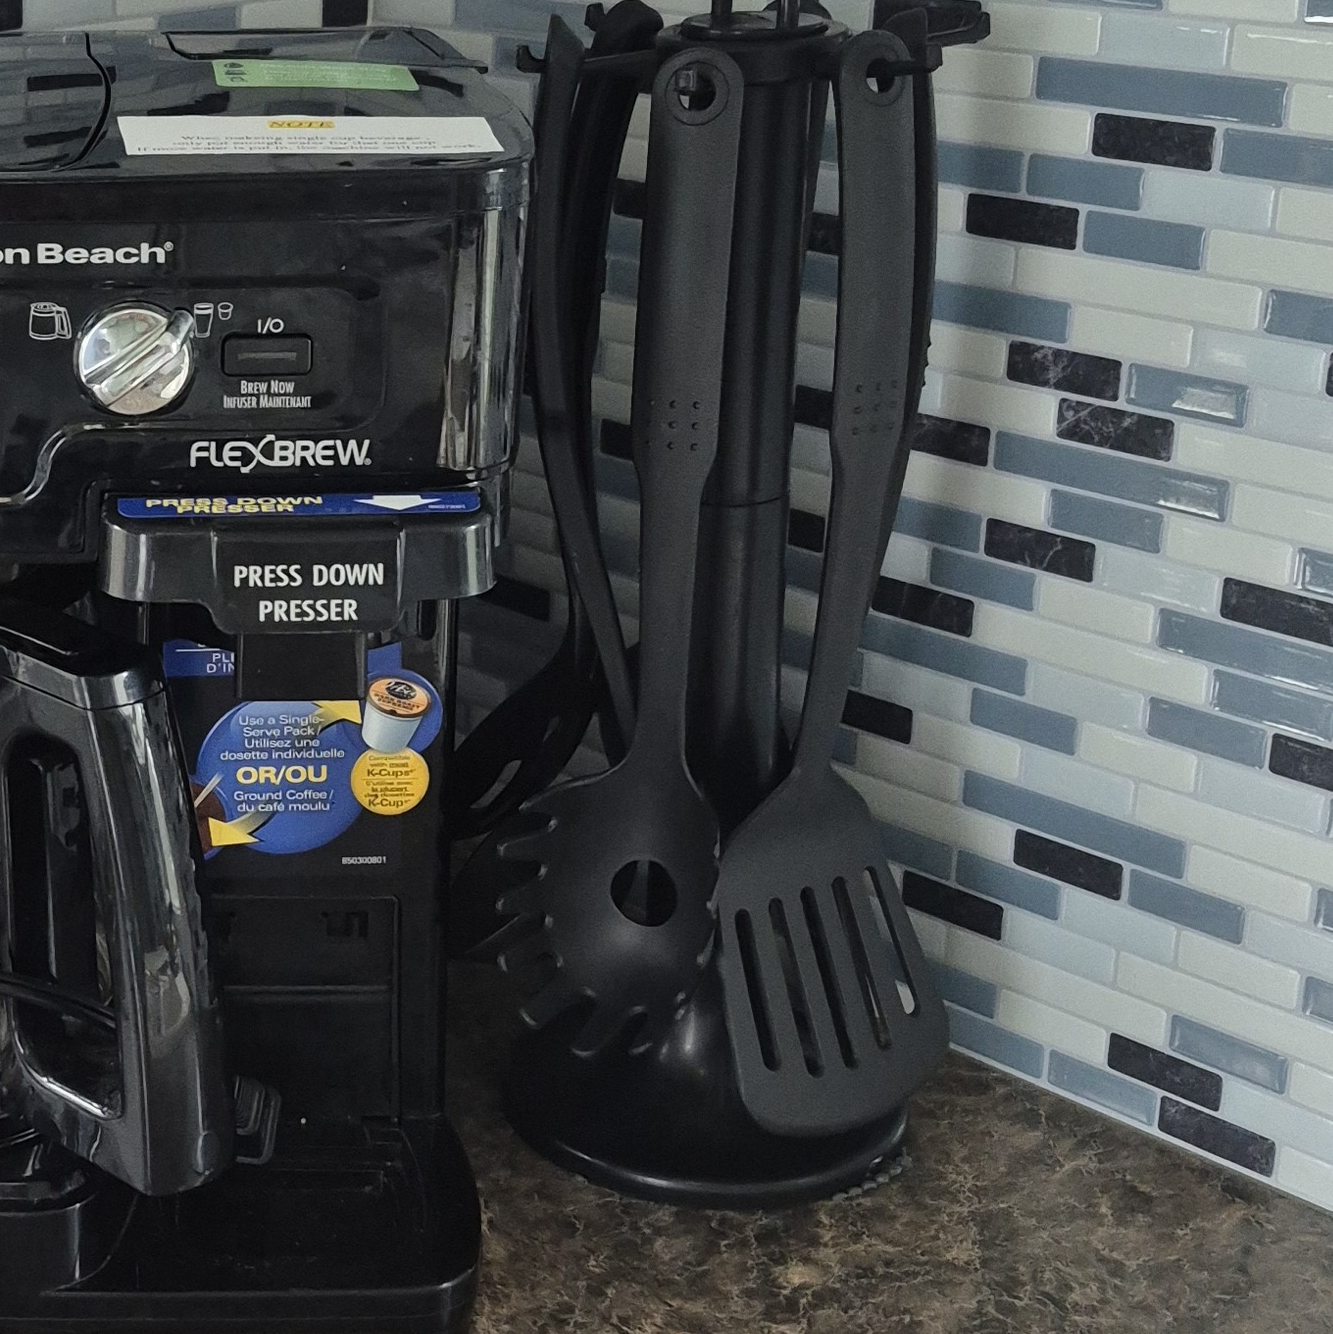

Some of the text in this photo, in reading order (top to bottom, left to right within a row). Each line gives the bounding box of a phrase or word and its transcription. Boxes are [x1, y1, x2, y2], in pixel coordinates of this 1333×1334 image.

[190, 434, 372, 473] FLEXBREW
[145, 495, 323, 509] PRESS DOWN
[176, 503, 295, 514] PRESSER
[233, 562, 385, 588] PRESS DOWN
[258, 598, 359, 623] PRESSER
[238, 716, 265, 726] Use
[267, 717, 276, 725] a
[242, 726, 281, 737] Serve
[244, 738, 321, 749] Utilisez une
[220, 748, 345, 761] dosette individuelle
[236, 764, 328, 785] OR/OU
[233, 790, 283, 801] Ground
[236, 801, 330, 812] du café moulu
